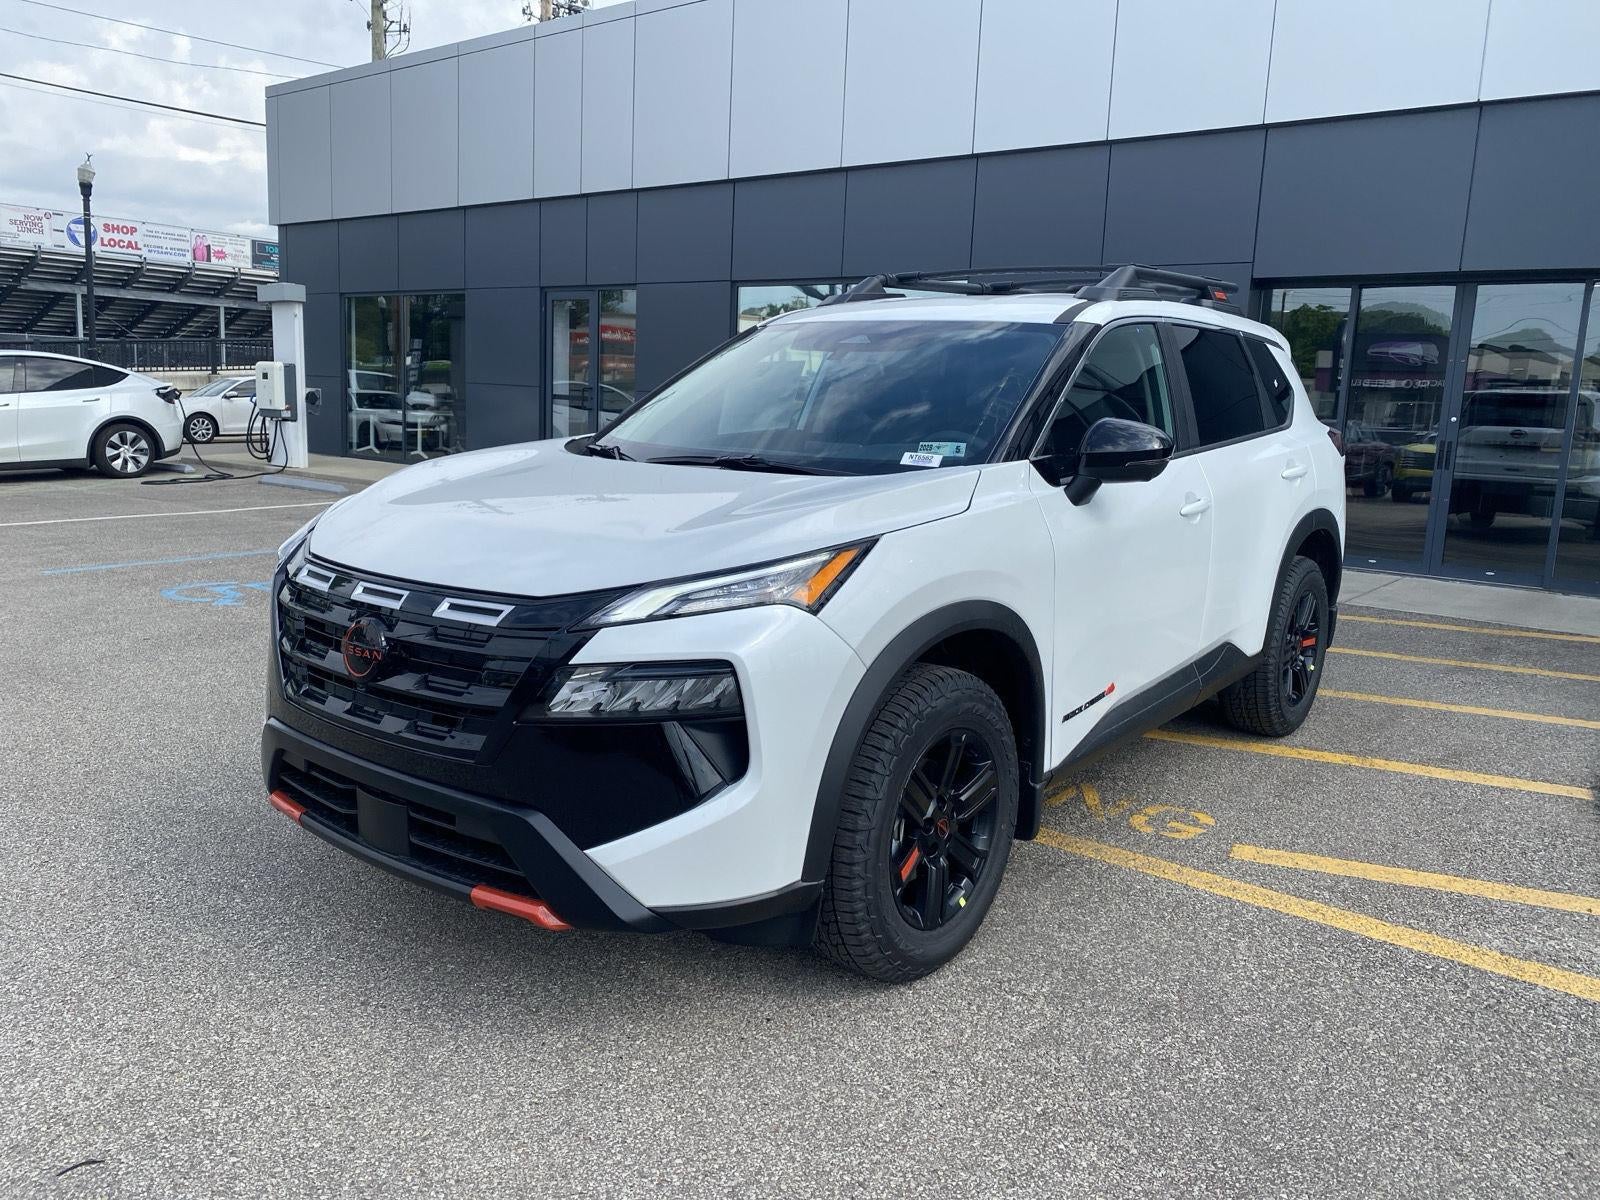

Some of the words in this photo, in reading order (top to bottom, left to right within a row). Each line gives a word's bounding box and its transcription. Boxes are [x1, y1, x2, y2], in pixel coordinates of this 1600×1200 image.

[9, 219, 44, 229] SERVING
[102, 223, 138, 236] SHOP
[16, 225, 44, 235] LUNCH
[100, 237, 141, 251] LOCAL
[955, 445, 961, 454] 5
[344, 643, 383, 661] SSAN
